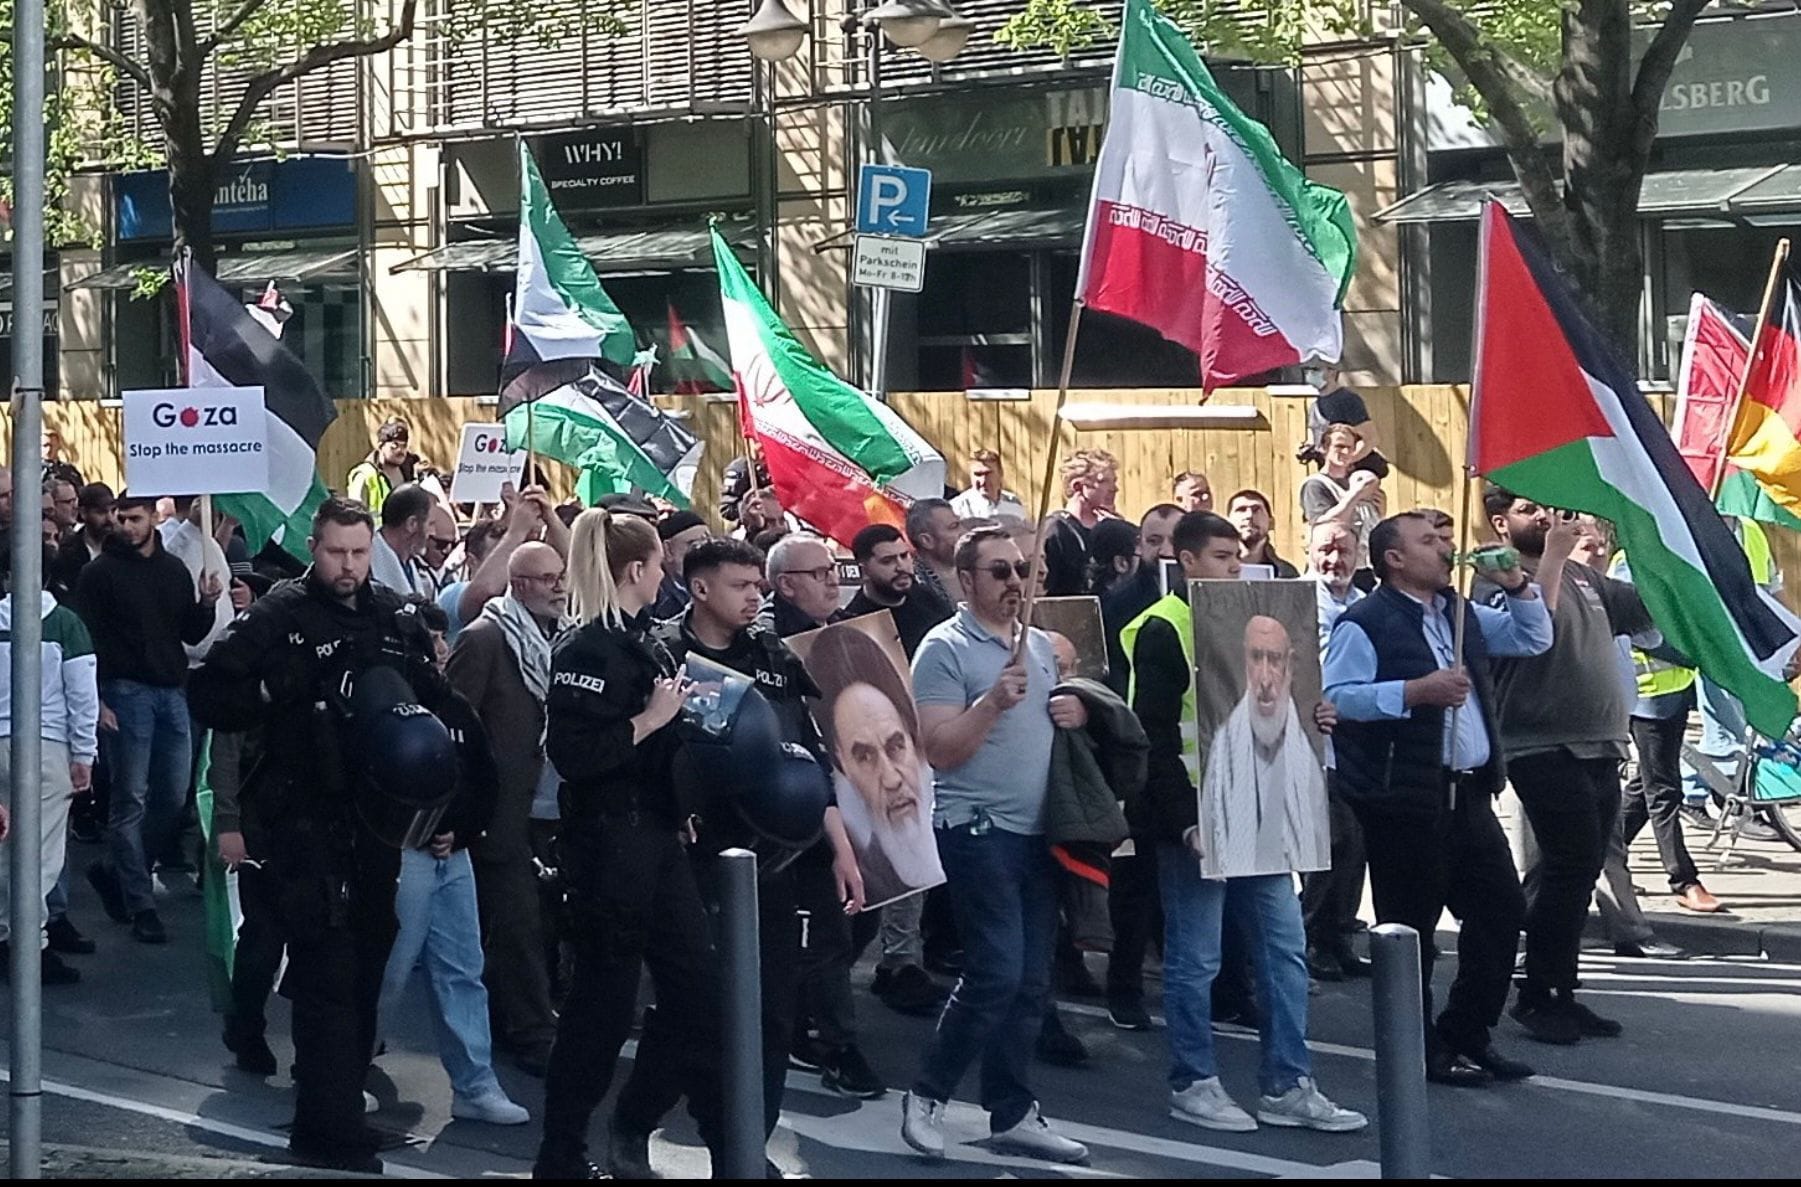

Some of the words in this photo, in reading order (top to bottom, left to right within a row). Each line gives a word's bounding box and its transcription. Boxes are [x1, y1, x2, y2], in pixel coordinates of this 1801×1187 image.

[564, 141, 622, 164] WHY!
[599, 174, 635, 186] COFFEE
[868, 174, 908, 224] P
[881, 246, 899, 255] mit
[860, 254, 918, 269] Parkschein
[152, 402, 237, 428] Gza
[129, 443, 162, 459] Stop
[165, 442, 189, 456] the
[192, 442, 262, 455] massacre
[553, 671, 605, 694] POLIZEI
